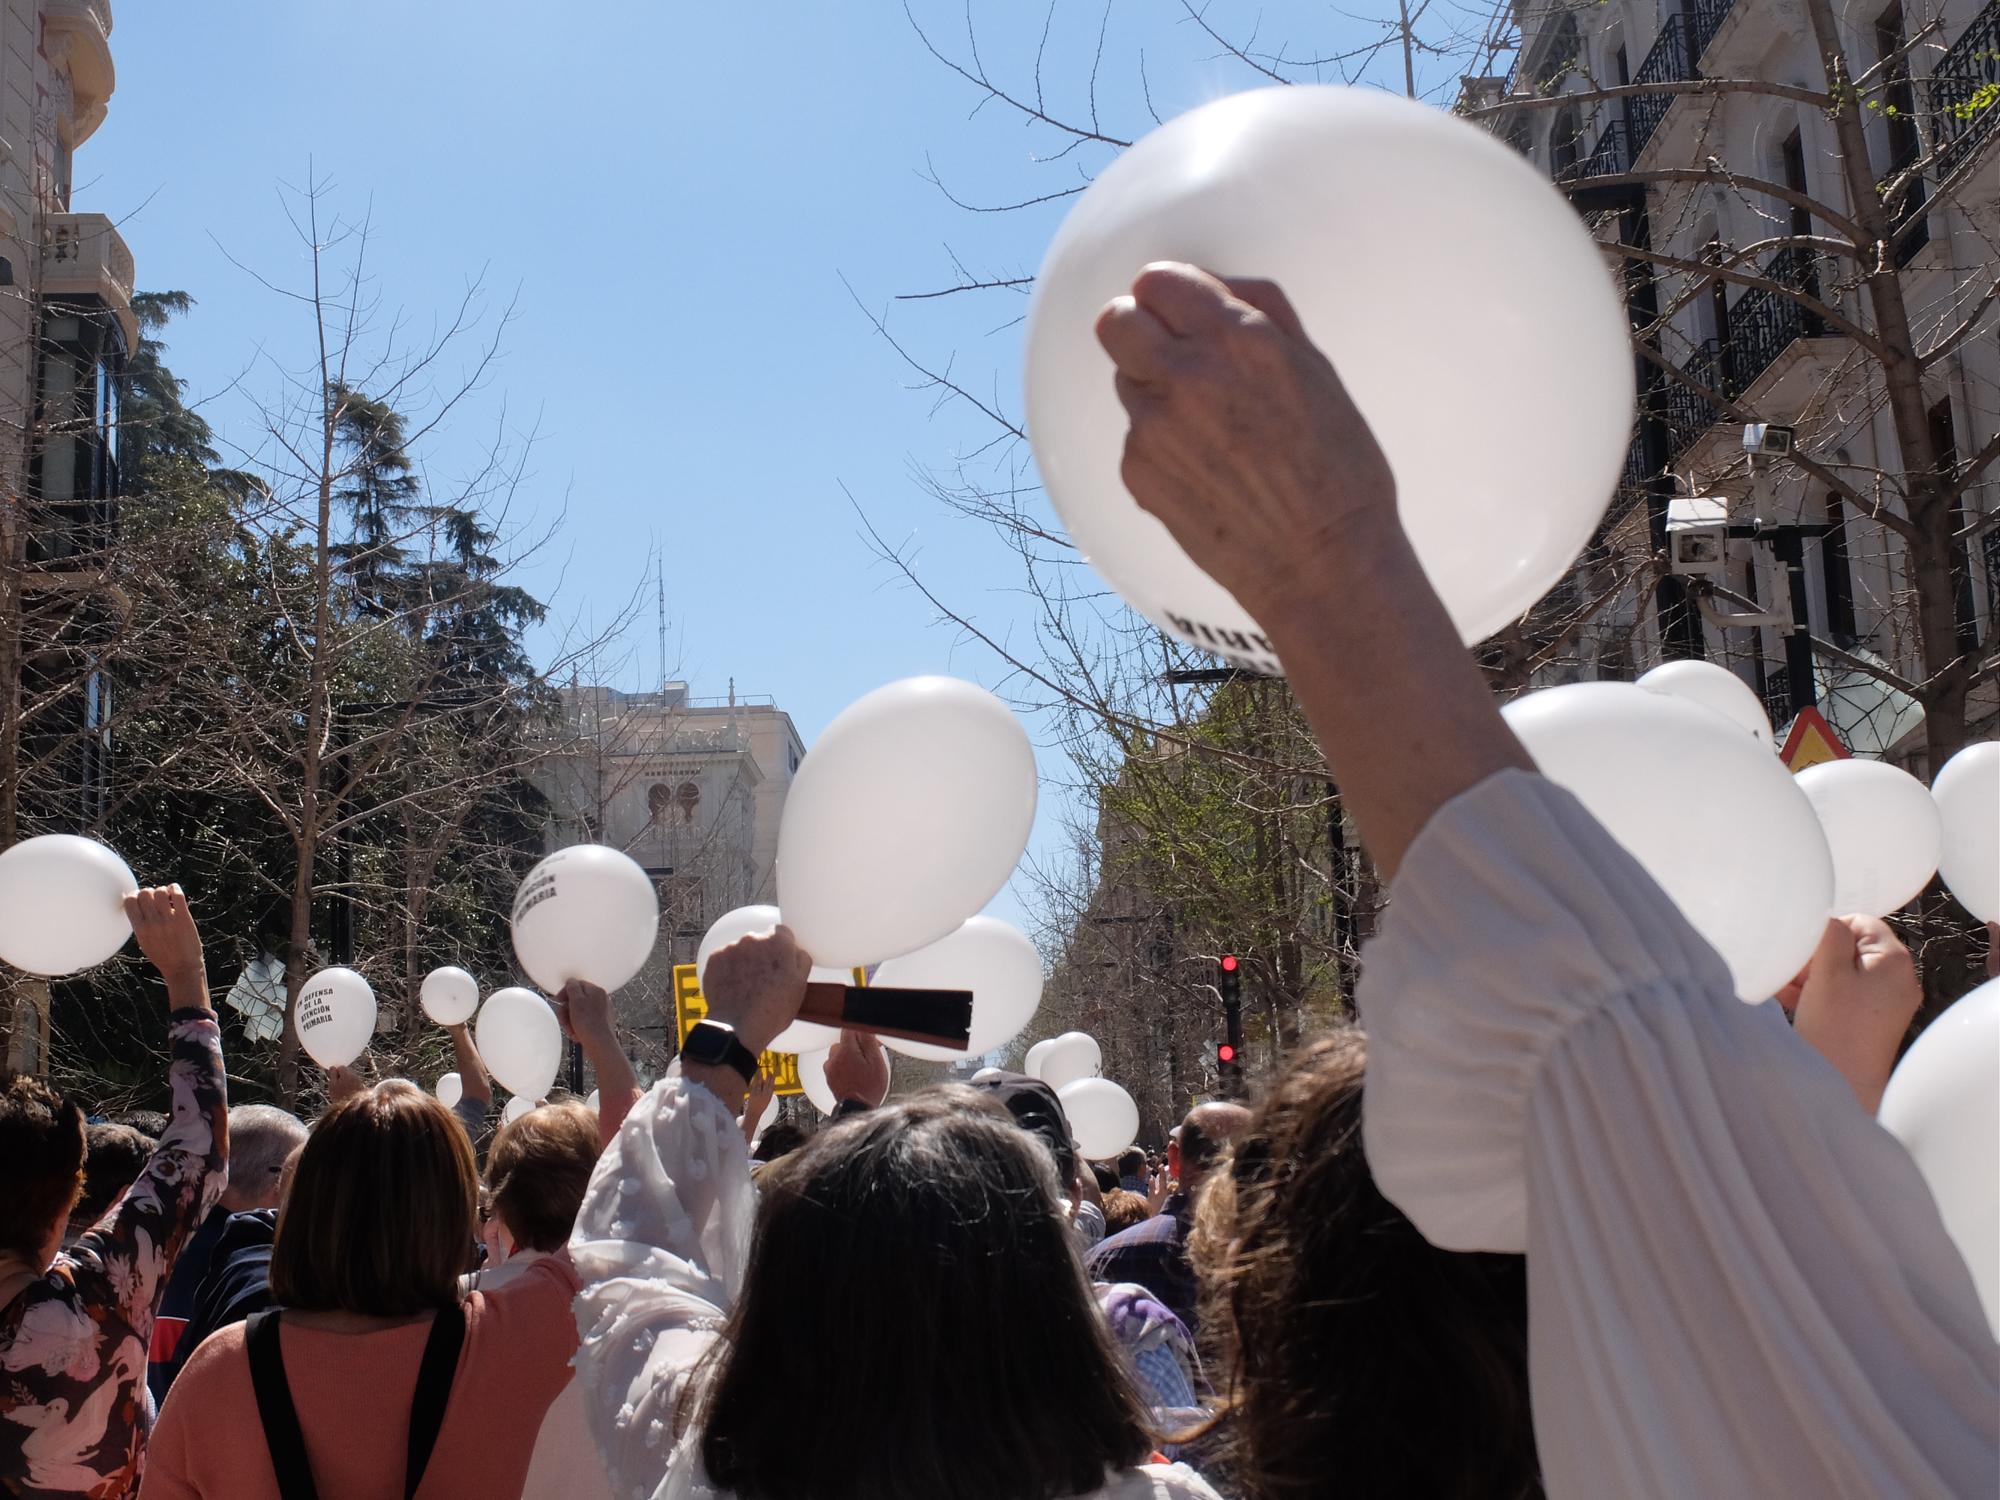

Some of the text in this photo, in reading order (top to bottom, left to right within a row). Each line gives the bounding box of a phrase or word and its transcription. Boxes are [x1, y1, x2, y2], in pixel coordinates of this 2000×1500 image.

[304, 988, 334, 1002] DEFENSA
[304, 997, 323, 1010] DE LA
[303, 1014, 333, 1032] PRIMARIA
